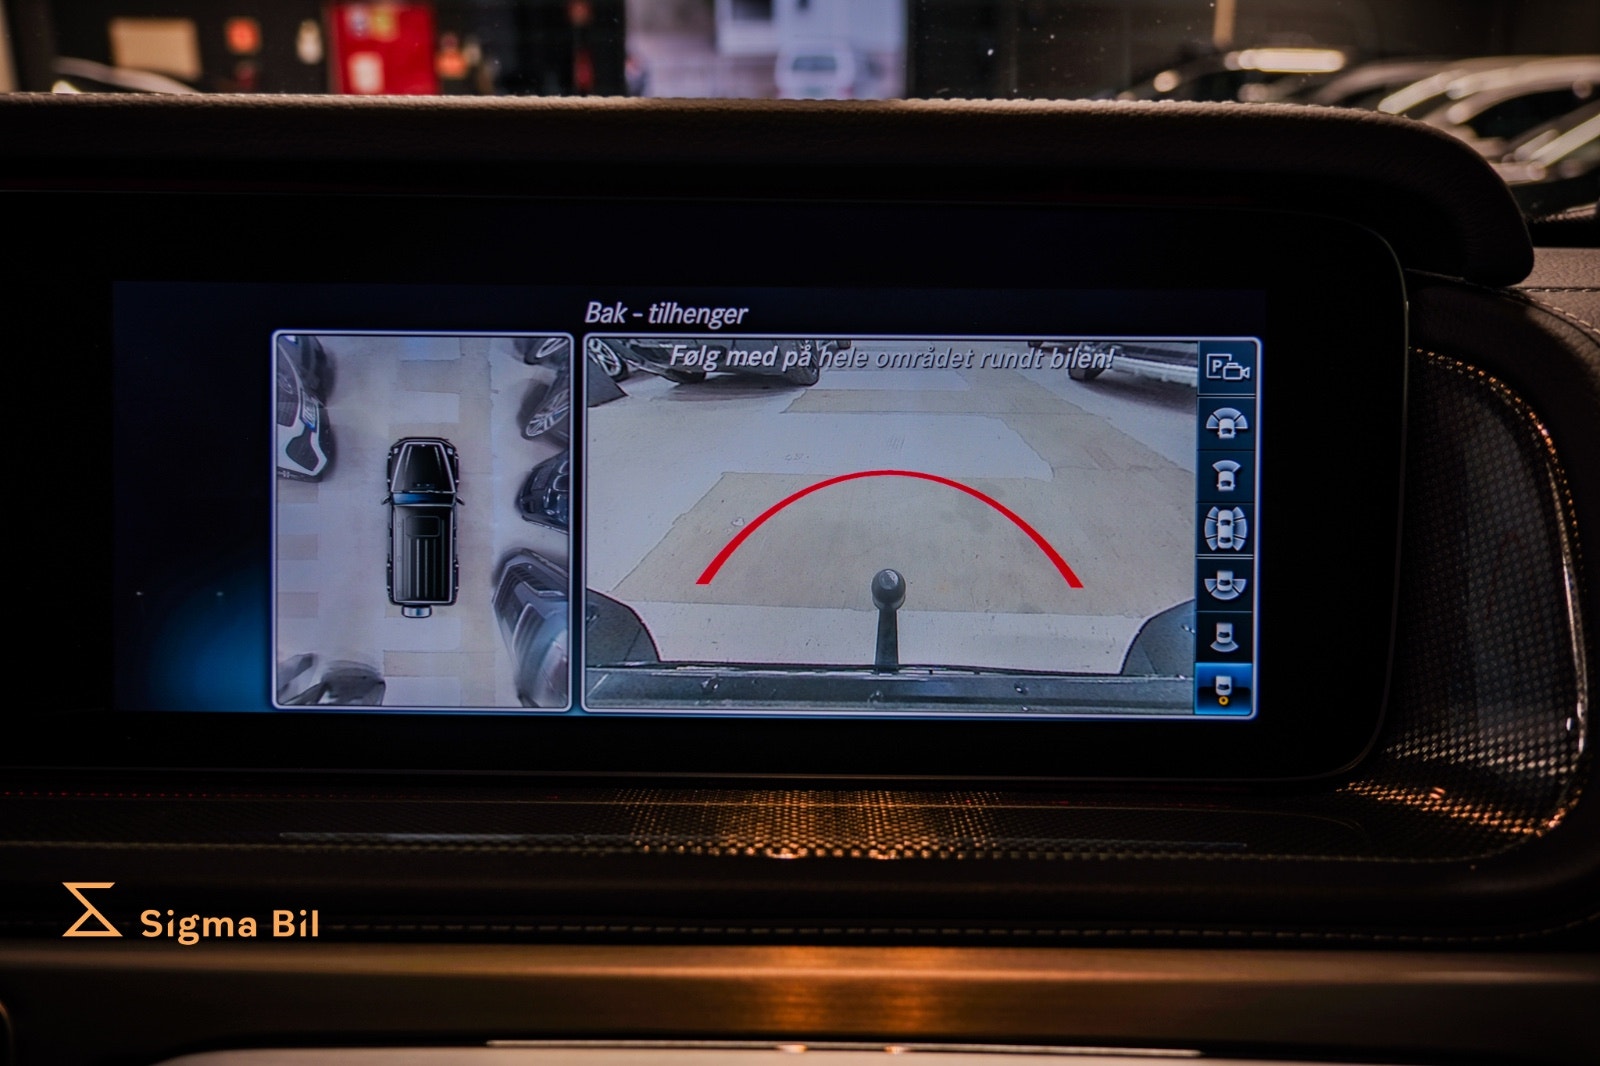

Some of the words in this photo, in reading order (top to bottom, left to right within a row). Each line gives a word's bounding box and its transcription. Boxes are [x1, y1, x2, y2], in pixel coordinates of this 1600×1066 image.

[585, 302, 628, 324] Bak
[648, 302, 748, 329] tilhenger
[670, 344, 719, 371] Følg
[724, 345, 778, 368] med
[781, 344, 812, 371] på
[818, 346, 870, 369] hele
[874, 345, 974, 370] området
[979, 346, 1045, 370] rundt
[1049, 346, 1114, 371] bilen!
